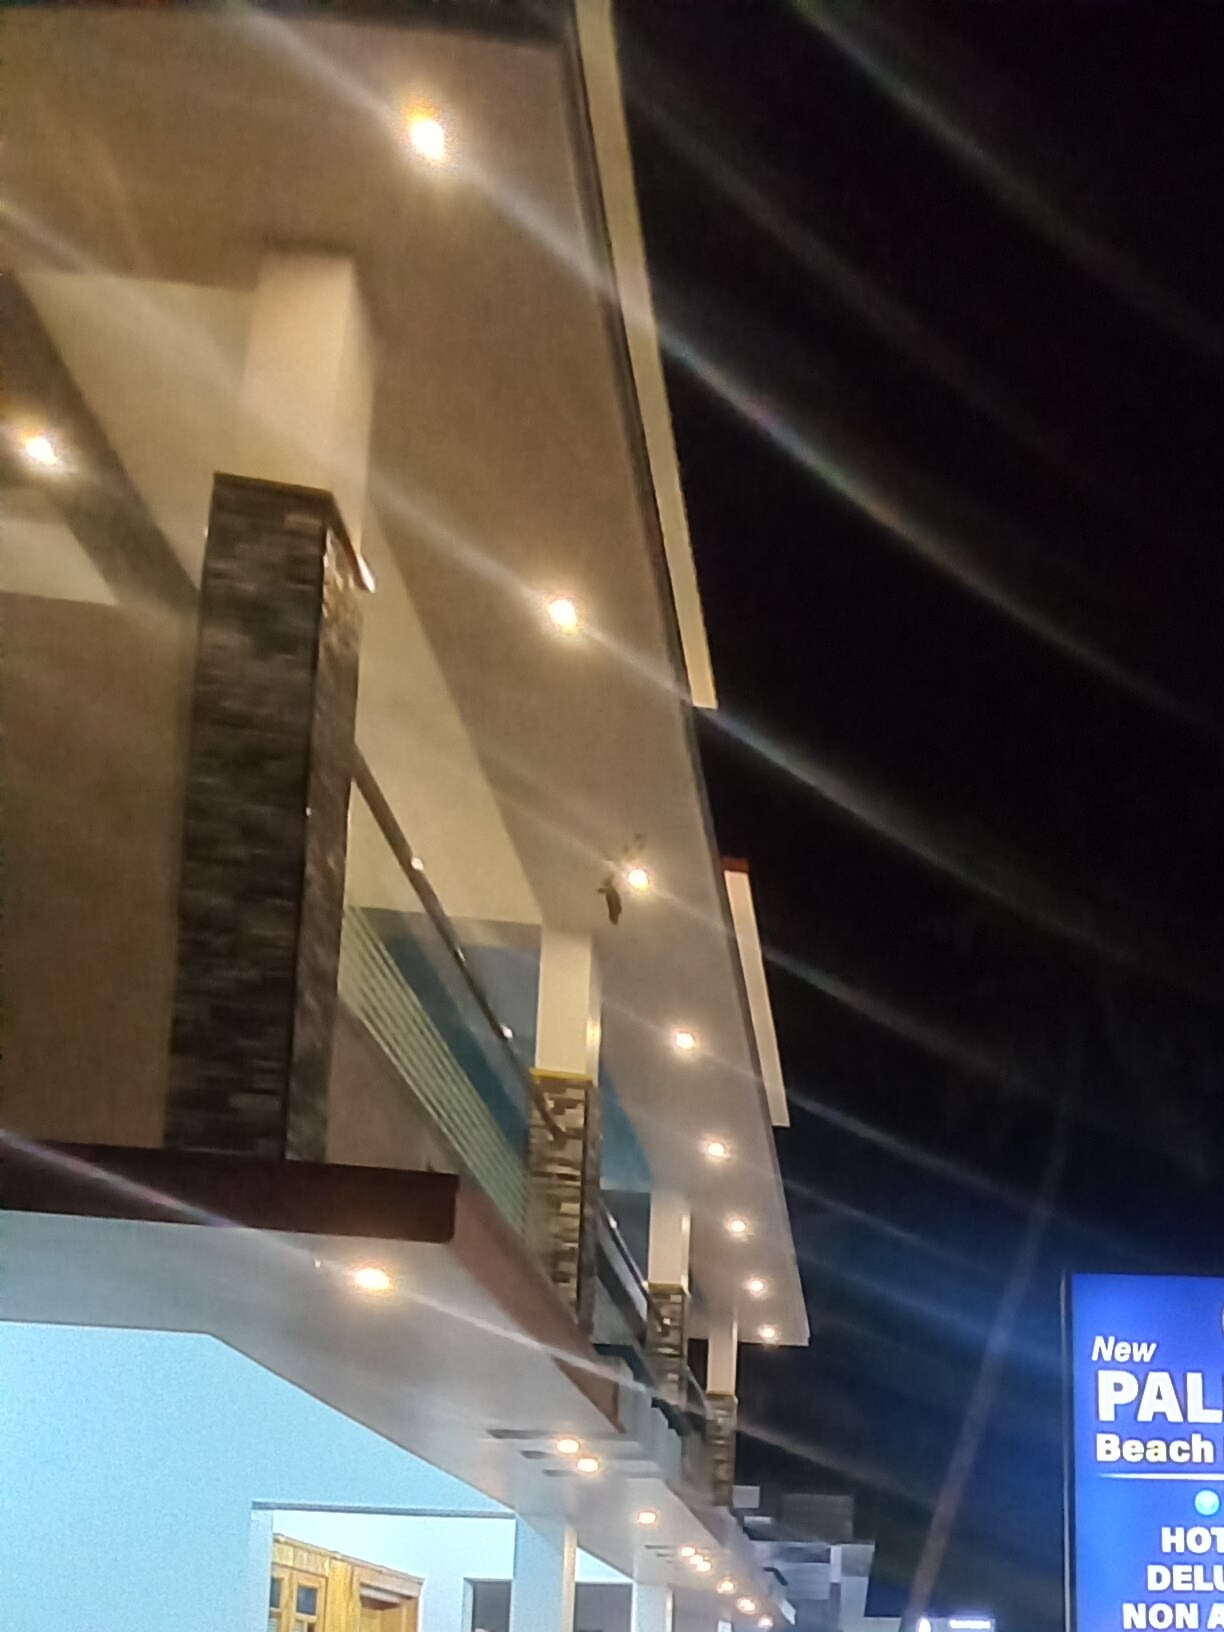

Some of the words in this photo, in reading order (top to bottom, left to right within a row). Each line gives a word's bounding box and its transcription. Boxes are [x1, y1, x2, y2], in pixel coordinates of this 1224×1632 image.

[1091, 1335, 1156, 1362] New
[1095, 1433, 1214, 1463] Beach
[1122, 1602, 1199, 1630] NON
